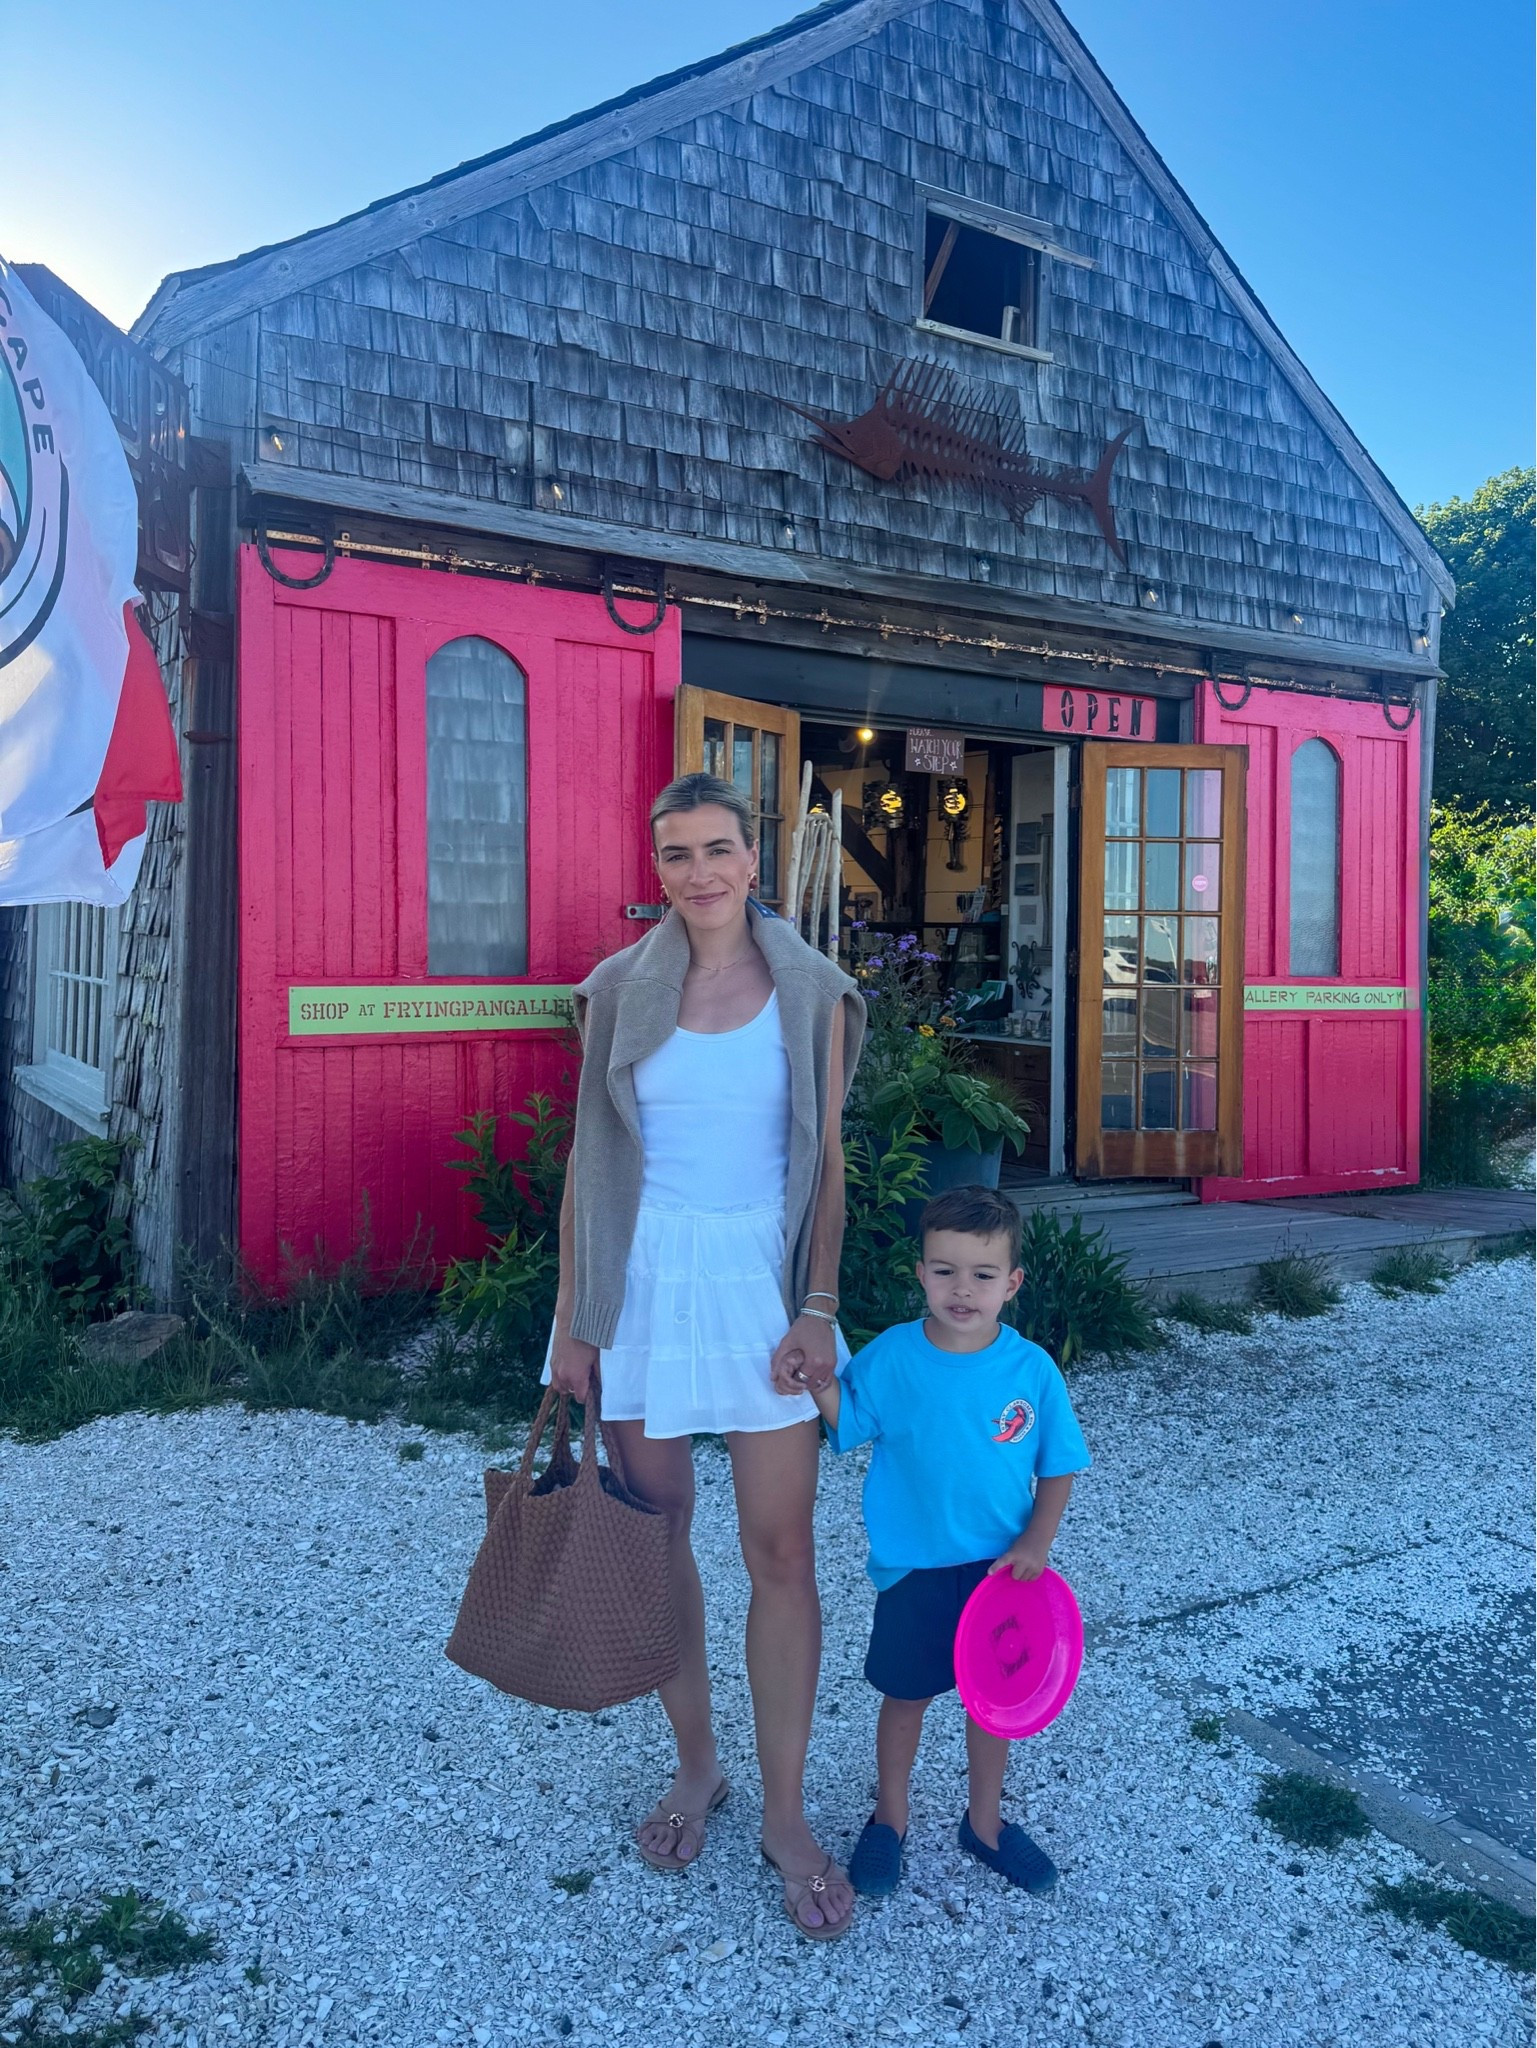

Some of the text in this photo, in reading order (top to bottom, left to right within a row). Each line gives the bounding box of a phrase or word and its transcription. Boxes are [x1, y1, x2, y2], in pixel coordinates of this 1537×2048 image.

[1060, 689, 1144, 737] OPEN
[910, 738, 940, 754] WATCH
[922, 754, 949, 774] STEP
[1245, 990, 1298, 1003] ALLERY
[1306, 991, 1360, 1004] PARKING
[301, 1000, 575, 1020] SHOP AT FRYINGPANGALLER
